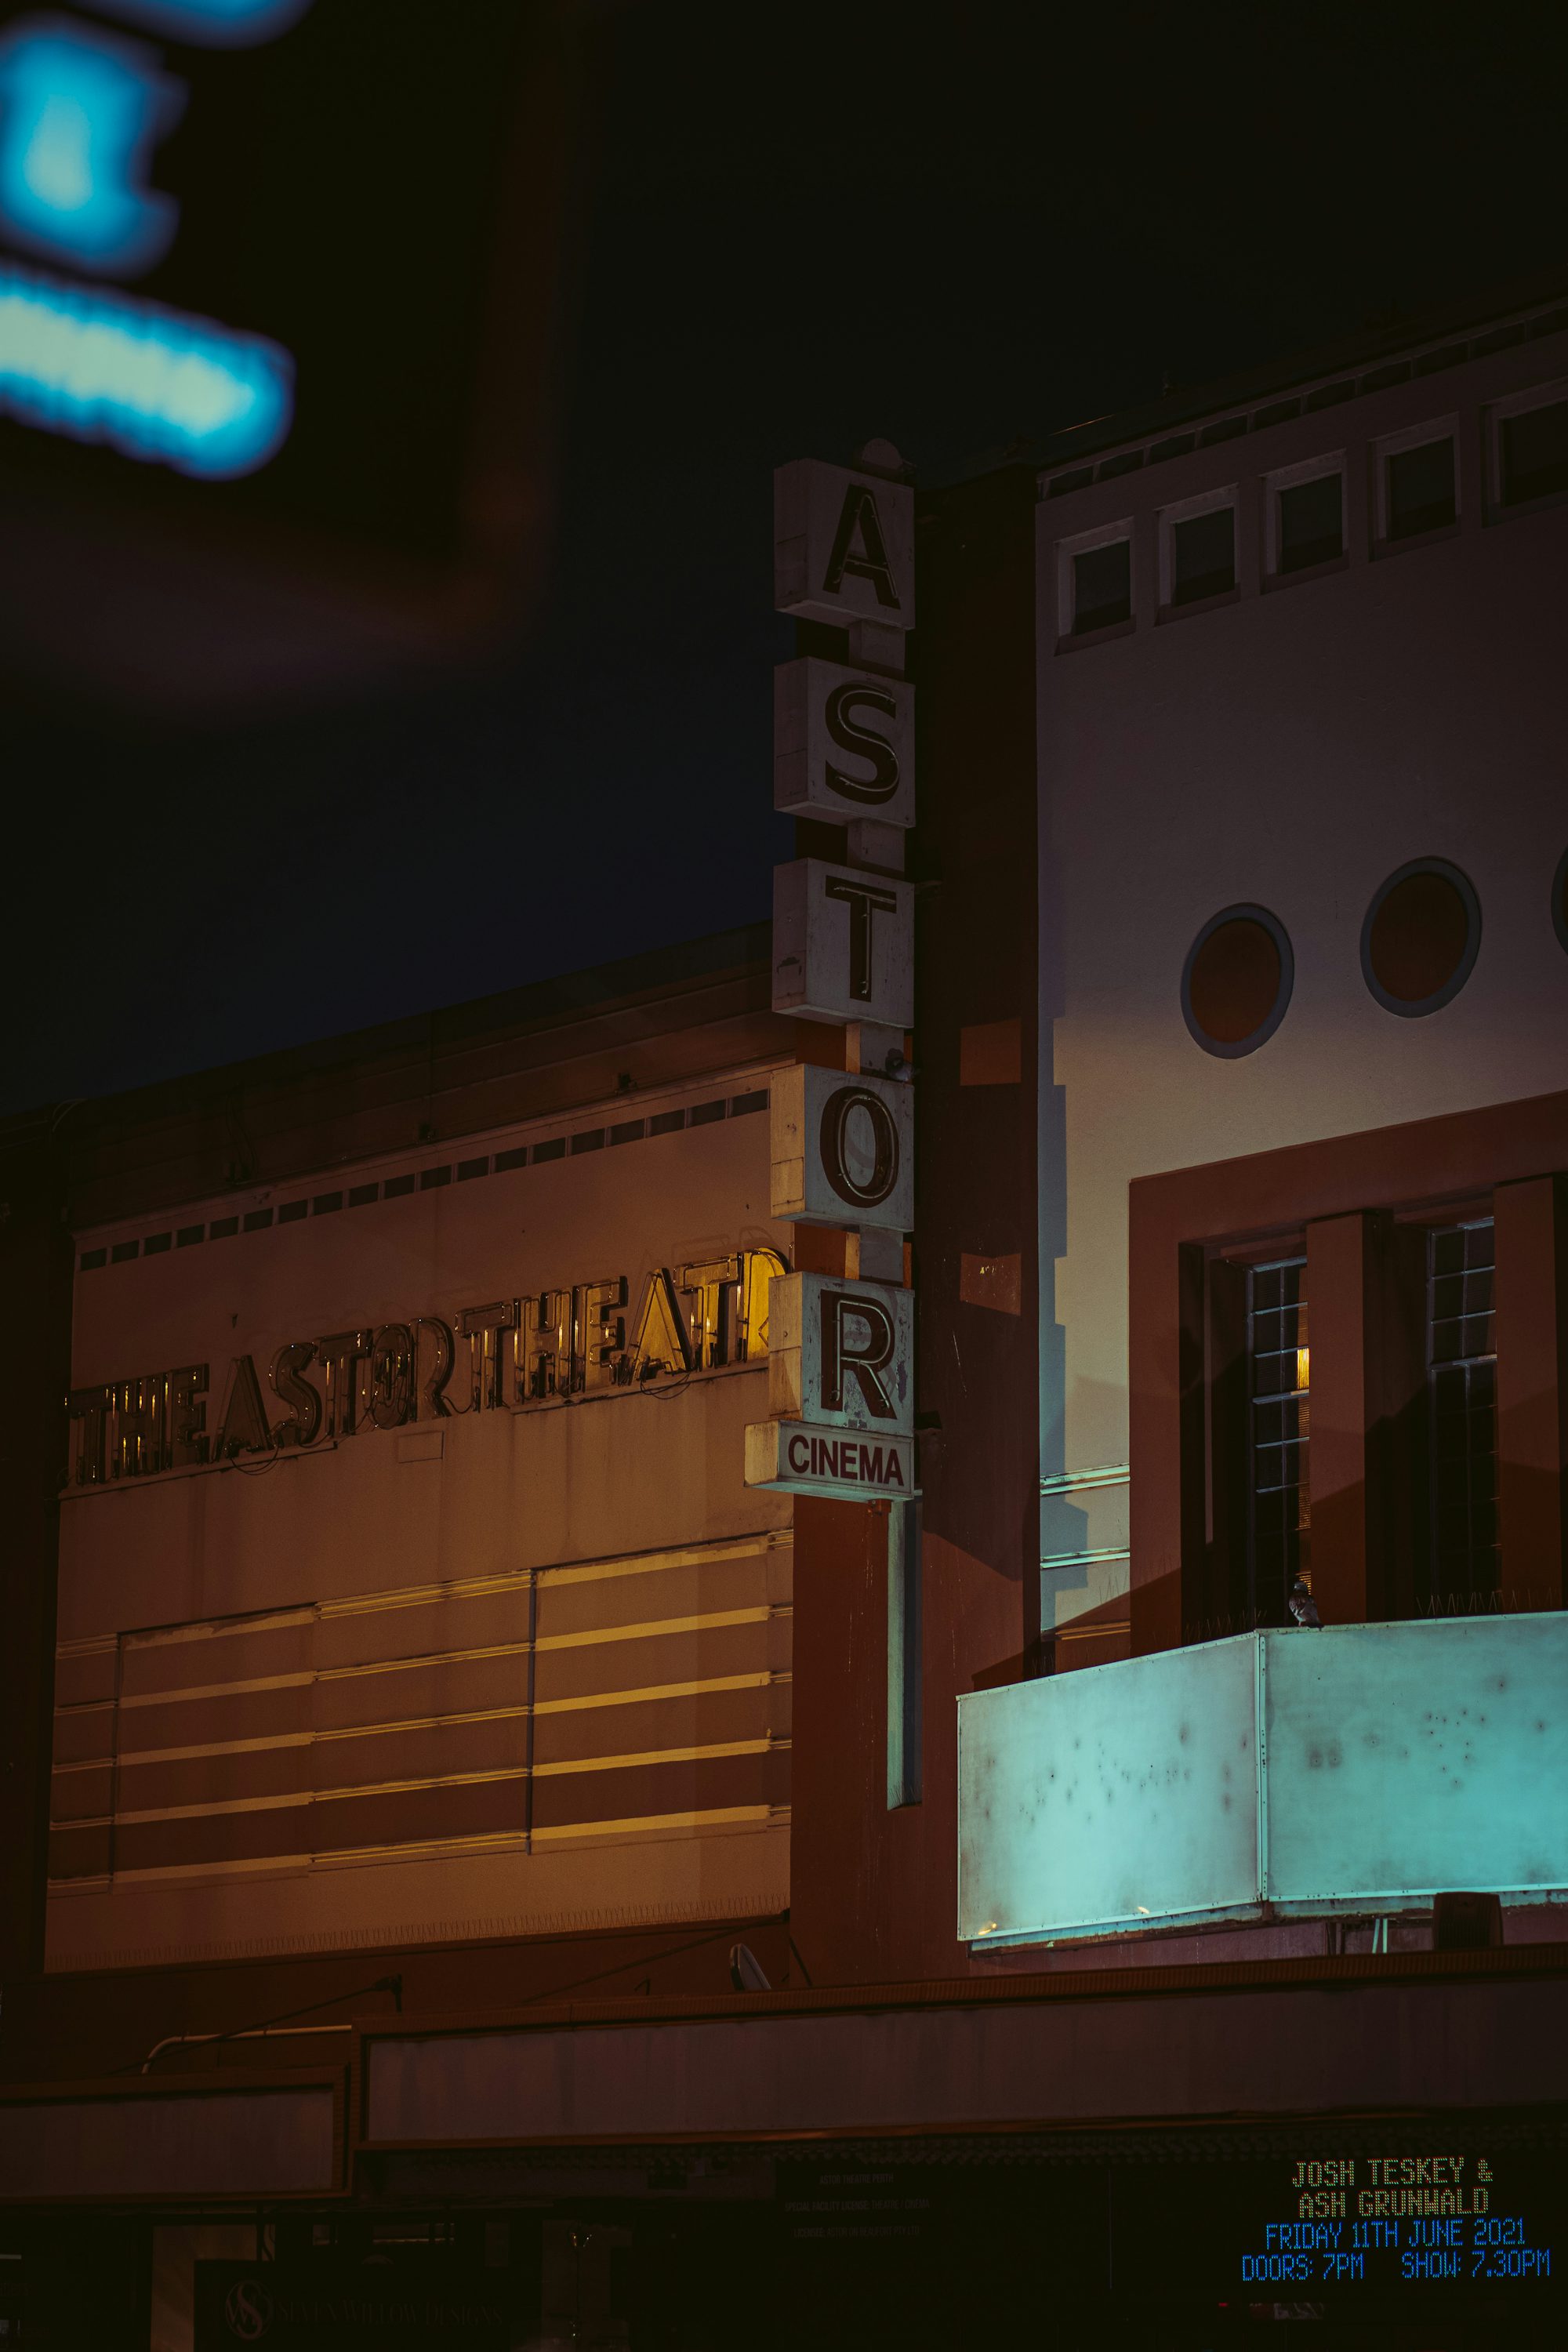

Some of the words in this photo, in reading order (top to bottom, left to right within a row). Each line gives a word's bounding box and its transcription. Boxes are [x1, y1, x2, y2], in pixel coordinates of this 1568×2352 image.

[818, 483, 901, 1420] ASTOR
[65, 1363, 209, 1485] THE
[213, 1317, 451, 1461] ASTOR
[788, 1434, 905, 1487] CINEMA
[1291, 2160, 1355, 2187] JOSH
[1367, 2157, 1465, 2185] TESKEY
[1477, 2158, 1494, 2183] &
[1298, 2191, 1347, 2219] ASH
[1357, 2187, 1490, 2217] GRUNWALD
[1265, 2223, 1343, 2250] FRIDAY
[1352, 2220, 1398, 2249] 11TH
[1408, 2219, 1465, 2247] JUNE
[1473, 2217, 1526, 2245] 2021
[1242, 2253, 1313, 2281] DOORS:
[1322, 2252, 1365, 2280] 7PM
[1400, 2250, 1461, 2279] SHOW:
[1471, 2249, 1551, 2278] 7.30PM
